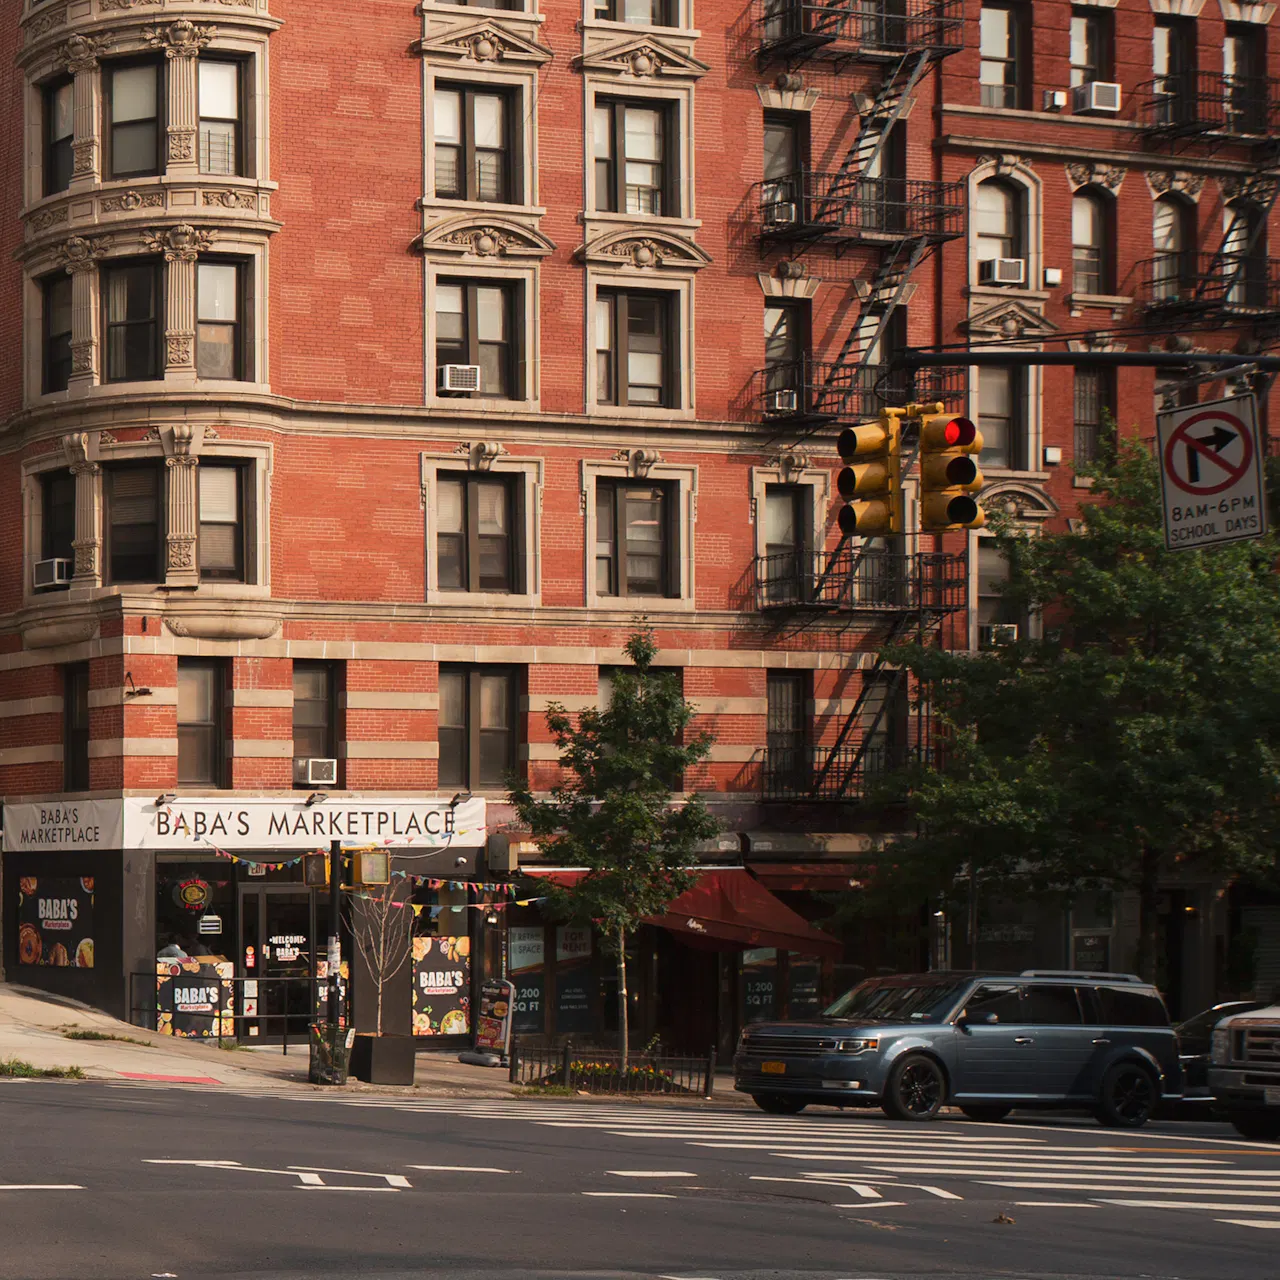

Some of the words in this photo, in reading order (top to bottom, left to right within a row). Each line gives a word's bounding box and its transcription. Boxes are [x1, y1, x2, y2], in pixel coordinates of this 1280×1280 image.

[1171, 495, 1255, 522] 8AM-6PM
[1171, 522, 1220, 542] SCHOOL
[1225, 515, 1258, 533] DAYS
[40, 808, 79, 824] BABA'S
[157, 811, 250, 836] BABA'S
[268, 810, 456, 836] MARKETPLACE
[20, 826, 100, 844] MARKETPLACE
[38, 898, 78, 920] BABA'S
[271, 935, 304, 944] WELCOME
[564, 931, 584, 941] FOR
[276, 947, 300, 957] BABA'S
[518, 945, 541, 954] SPACE
[562, 942, 588, 952] RENT
[419, 970, 464, 987] BABA'S
[747, 982, 773, 993] 1,200
[174, 986, 219, 1004] BABA'S
[513, 988, 540, 999] 1,200
[746, 995, 761, 1005] SQ
[762, 995, 773, 1005] FT
[512, 1001, 527, 1012] SQ
[529, 1001, 540, 1011] FT
